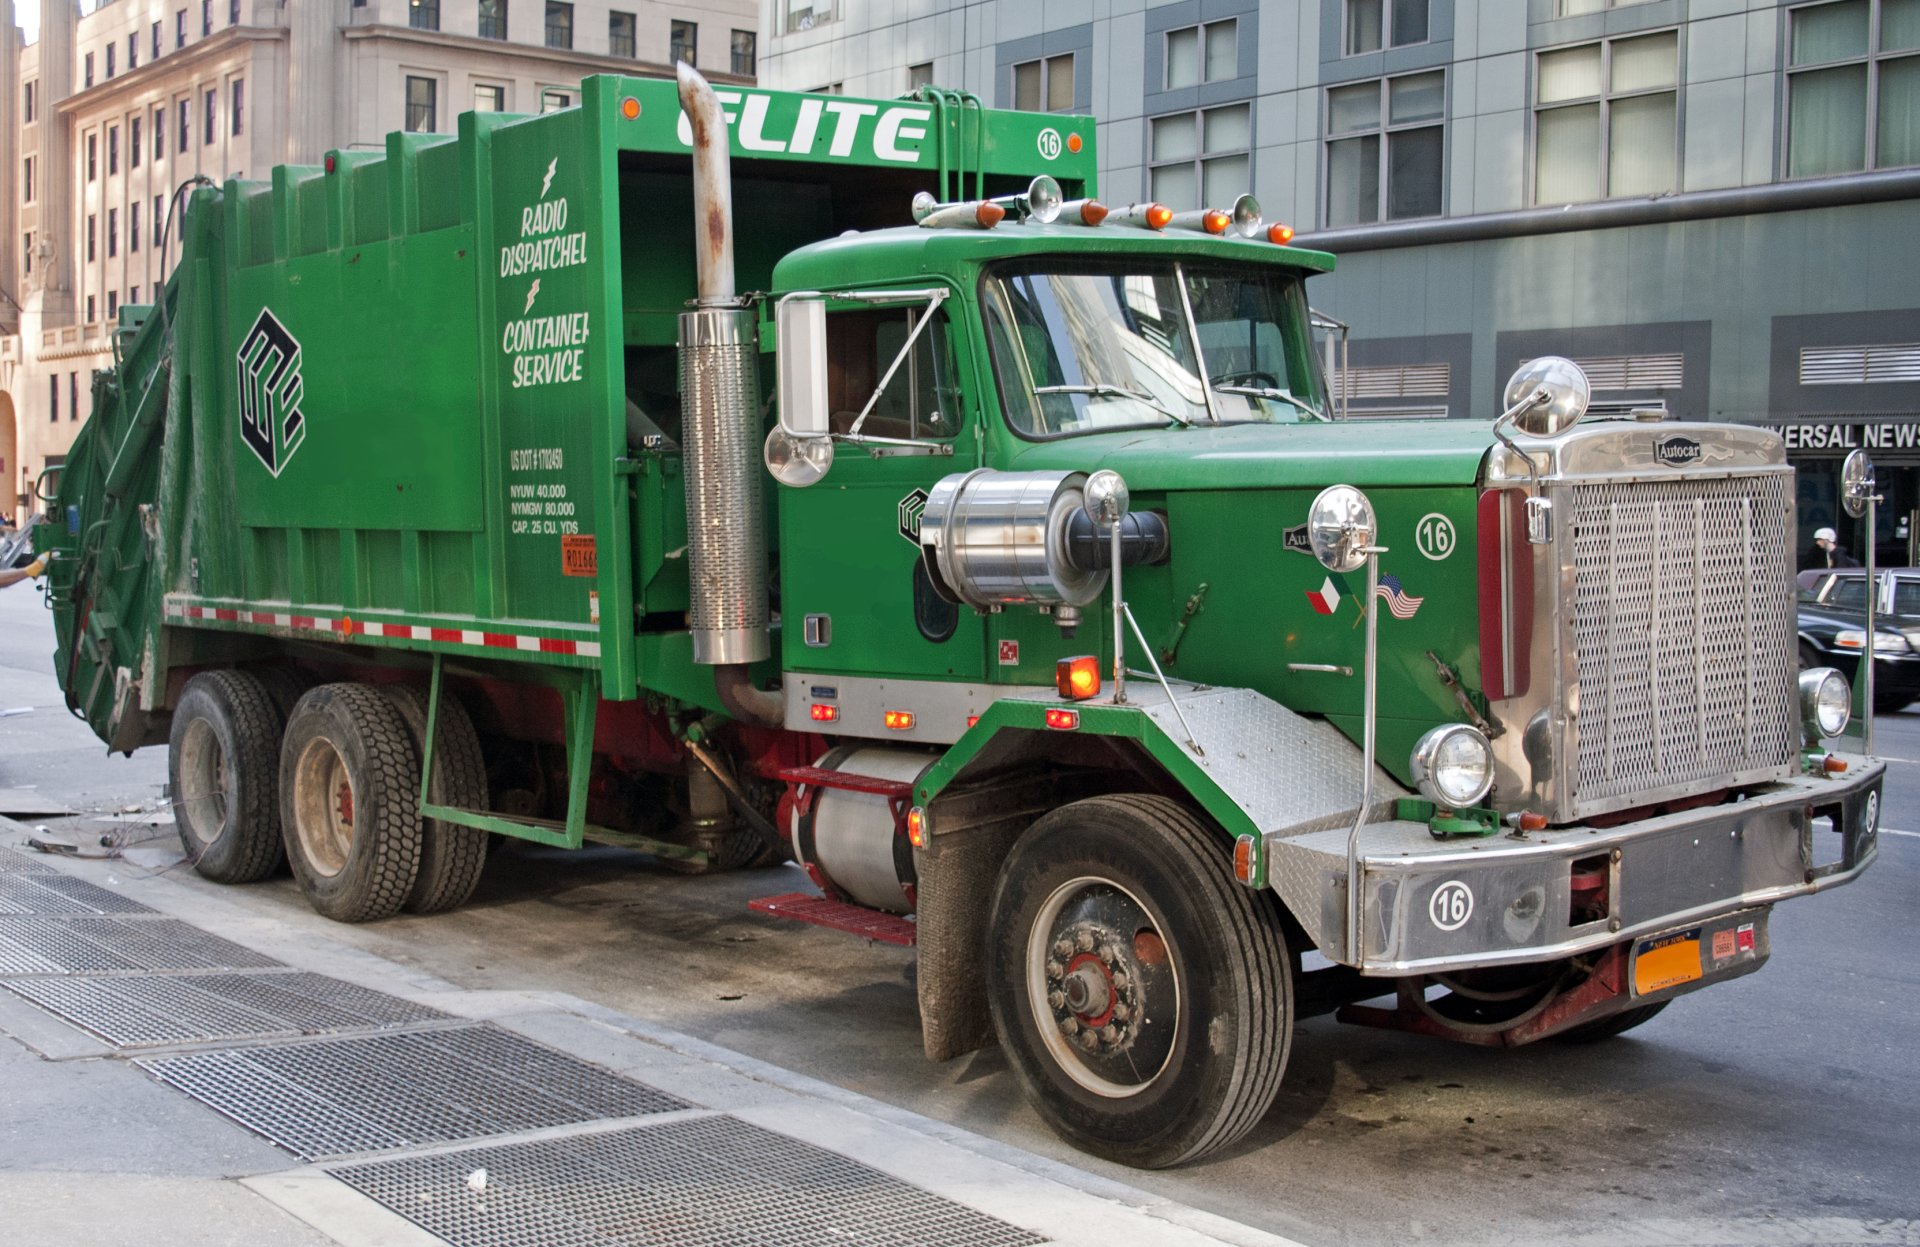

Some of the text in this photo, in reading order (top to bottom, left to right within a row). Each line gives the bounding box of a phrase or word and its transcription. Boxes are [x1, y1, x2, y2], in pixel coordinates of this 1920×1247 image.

[521, 198, 567, 237] RADIO
[512, 349, 584, 389] SERVICE
[511, 450, 520, 470] US
[520, 449, 532, 470] DOT
[1660, 444, 1699, 458] Autocar
[510, 484, 535, 498] NYUW
[511, 502, 542, 516] NYMGW
[512, 521, 579, 535] CAP. 25 CU. YDS
[1423, 521, 1448, 551] 16
[1438, 888, 1465, 922] 16
